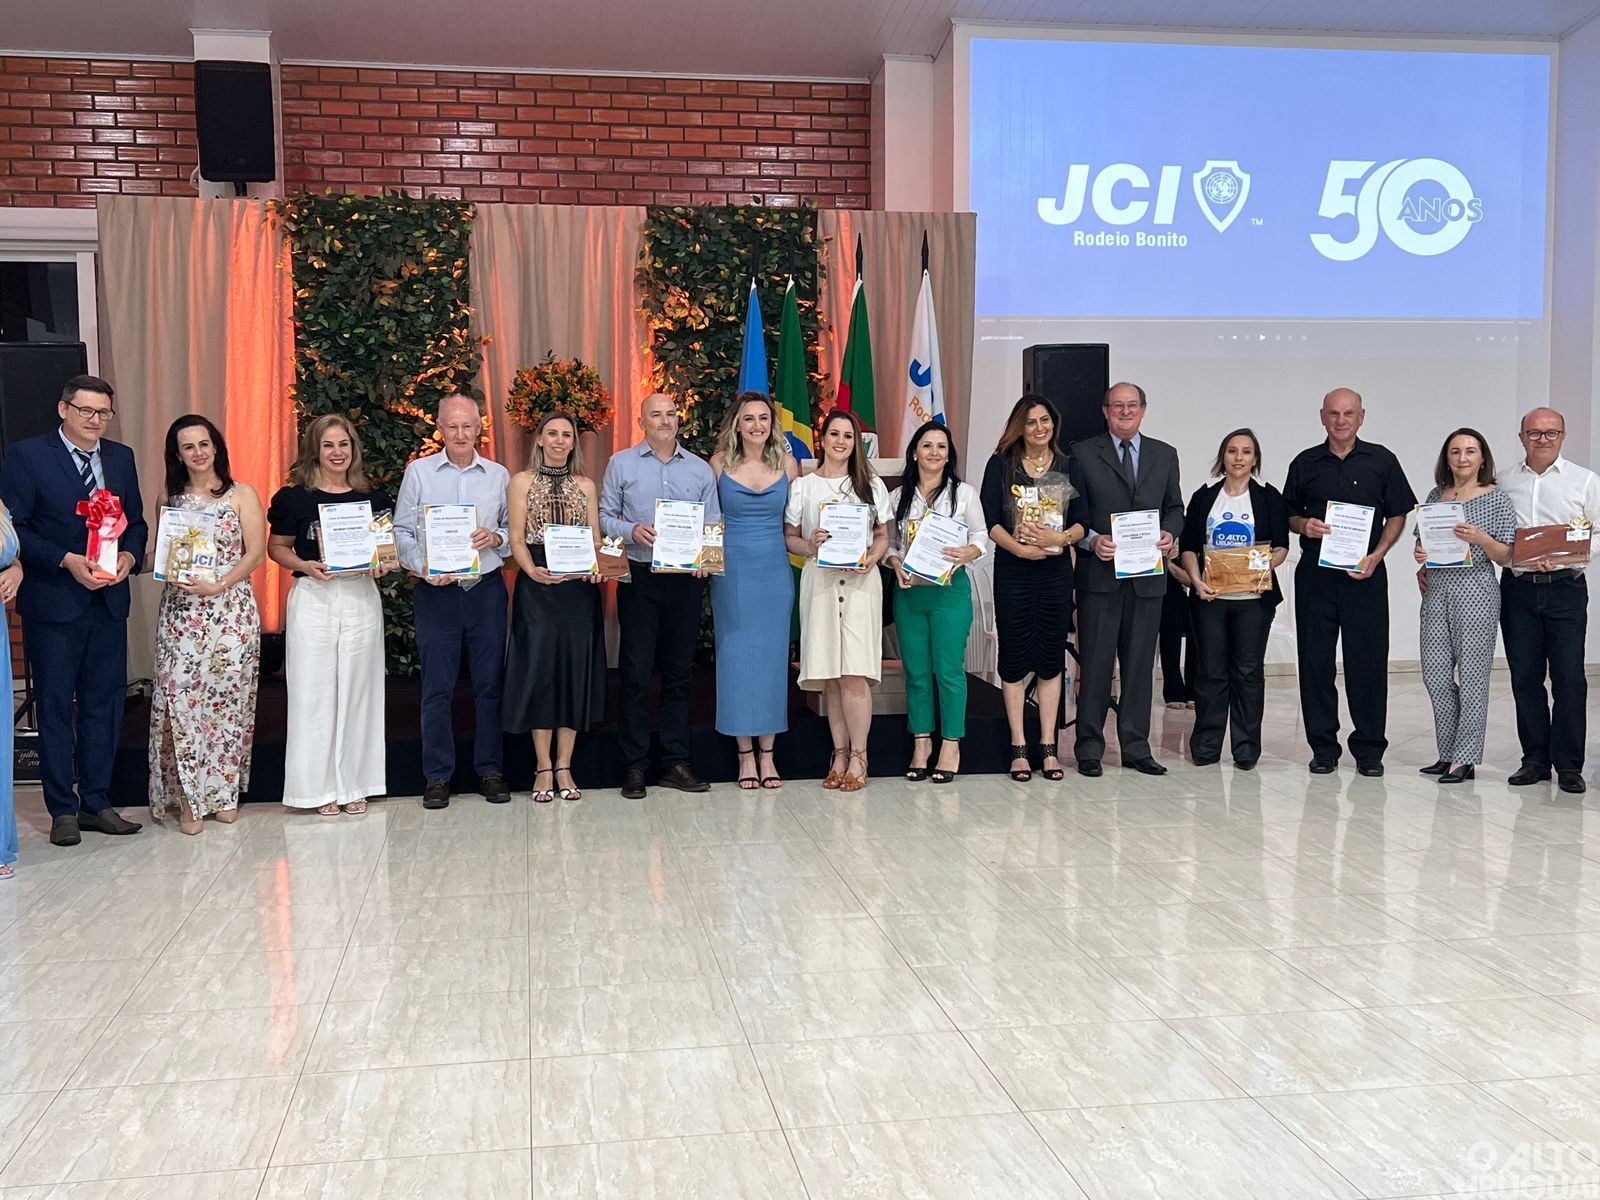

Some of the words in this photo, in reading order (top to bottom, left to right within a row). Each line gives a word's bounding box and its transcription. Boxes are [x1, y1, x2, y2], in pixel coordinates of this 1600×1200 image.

[1037, 163, 1182, 226] JCI
[1309, 158, 1475, 262] 50
[1396, 196, 1484, 224] ANOS
[1251, 218, 1264, 226] TM
[1073, 230, 1130, 247] Rodeio
[1135, 231, 1188, 247] Bonito
[1226, 534, 1248, 542] ALTO
